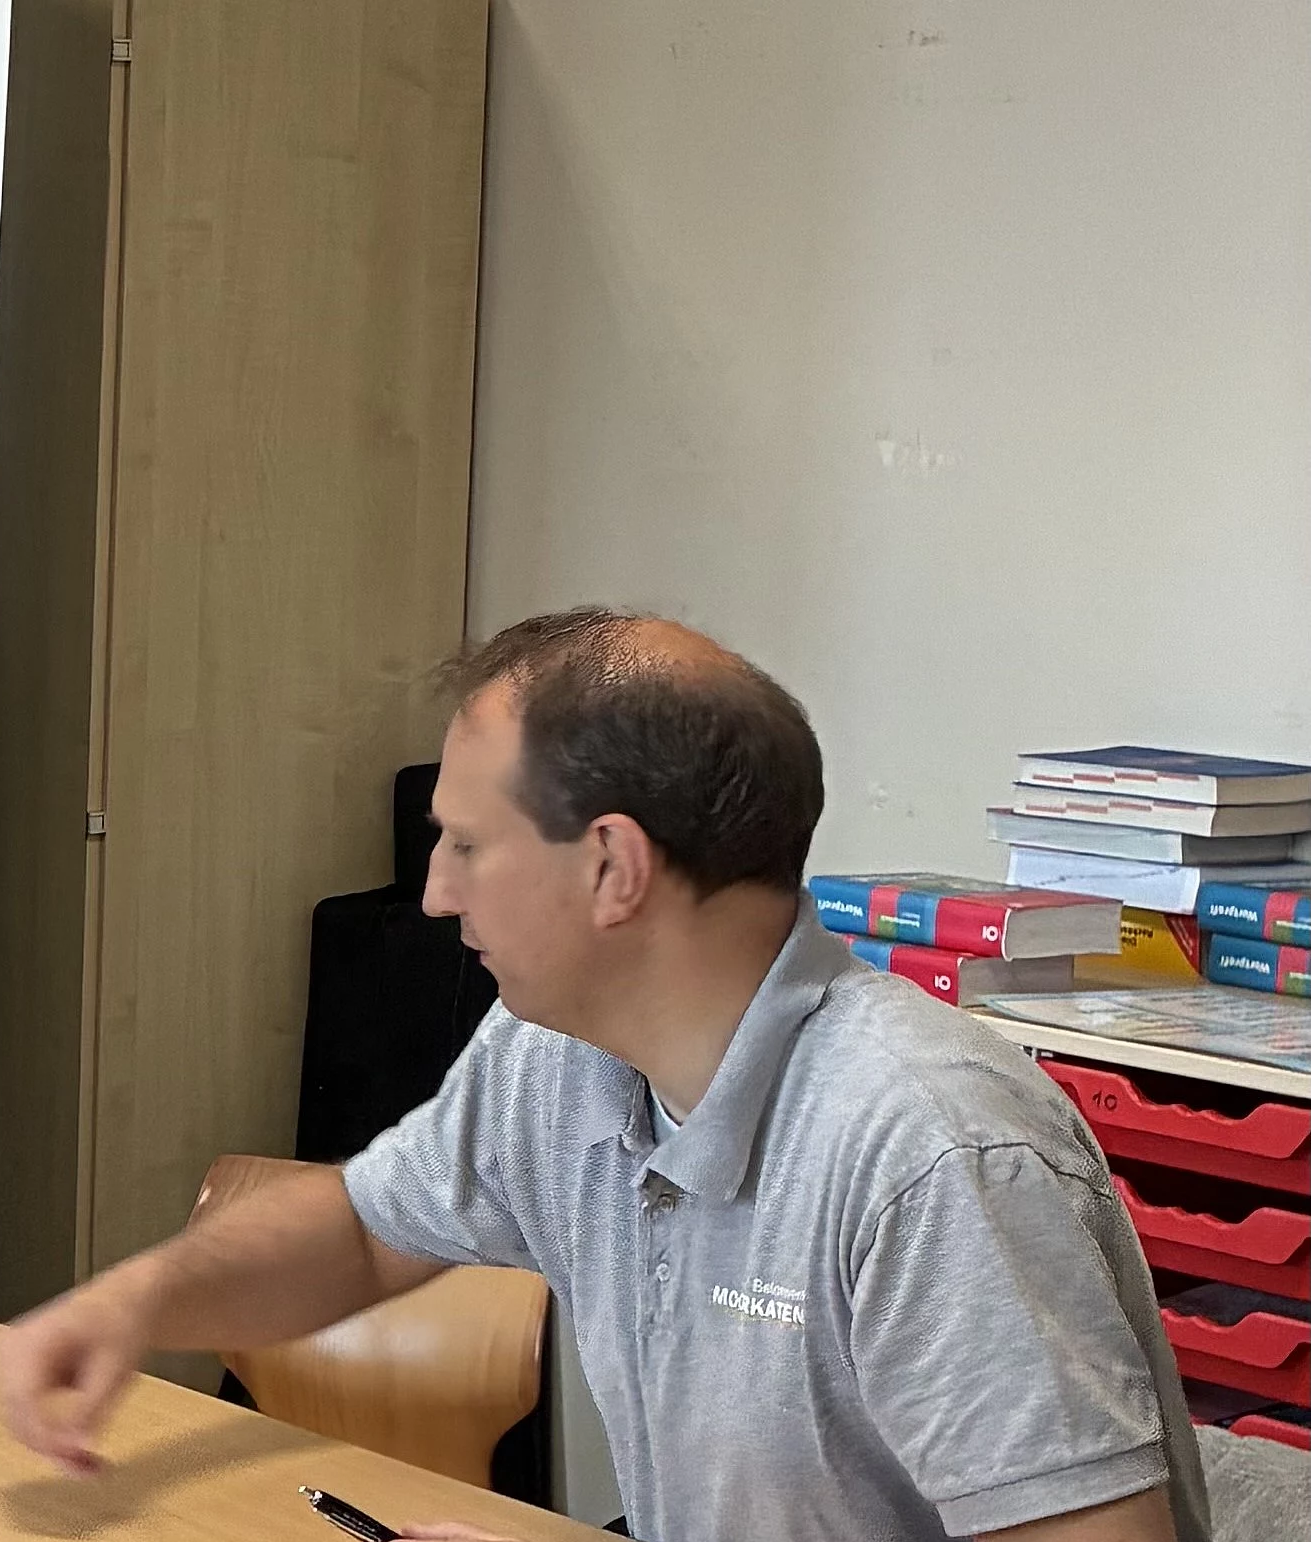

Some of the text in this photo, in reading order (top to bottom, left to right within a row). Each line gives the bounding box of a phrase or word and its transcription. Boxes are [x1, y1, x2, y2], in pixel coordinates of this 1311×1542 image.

[818, 899, 864, 917] Wortprofi
[1209, 904, 1258, 923] Wortprofi
[1220, 955, 1270, 975] Wortprofi
[1092, 1090, 1119, 1111] 10
